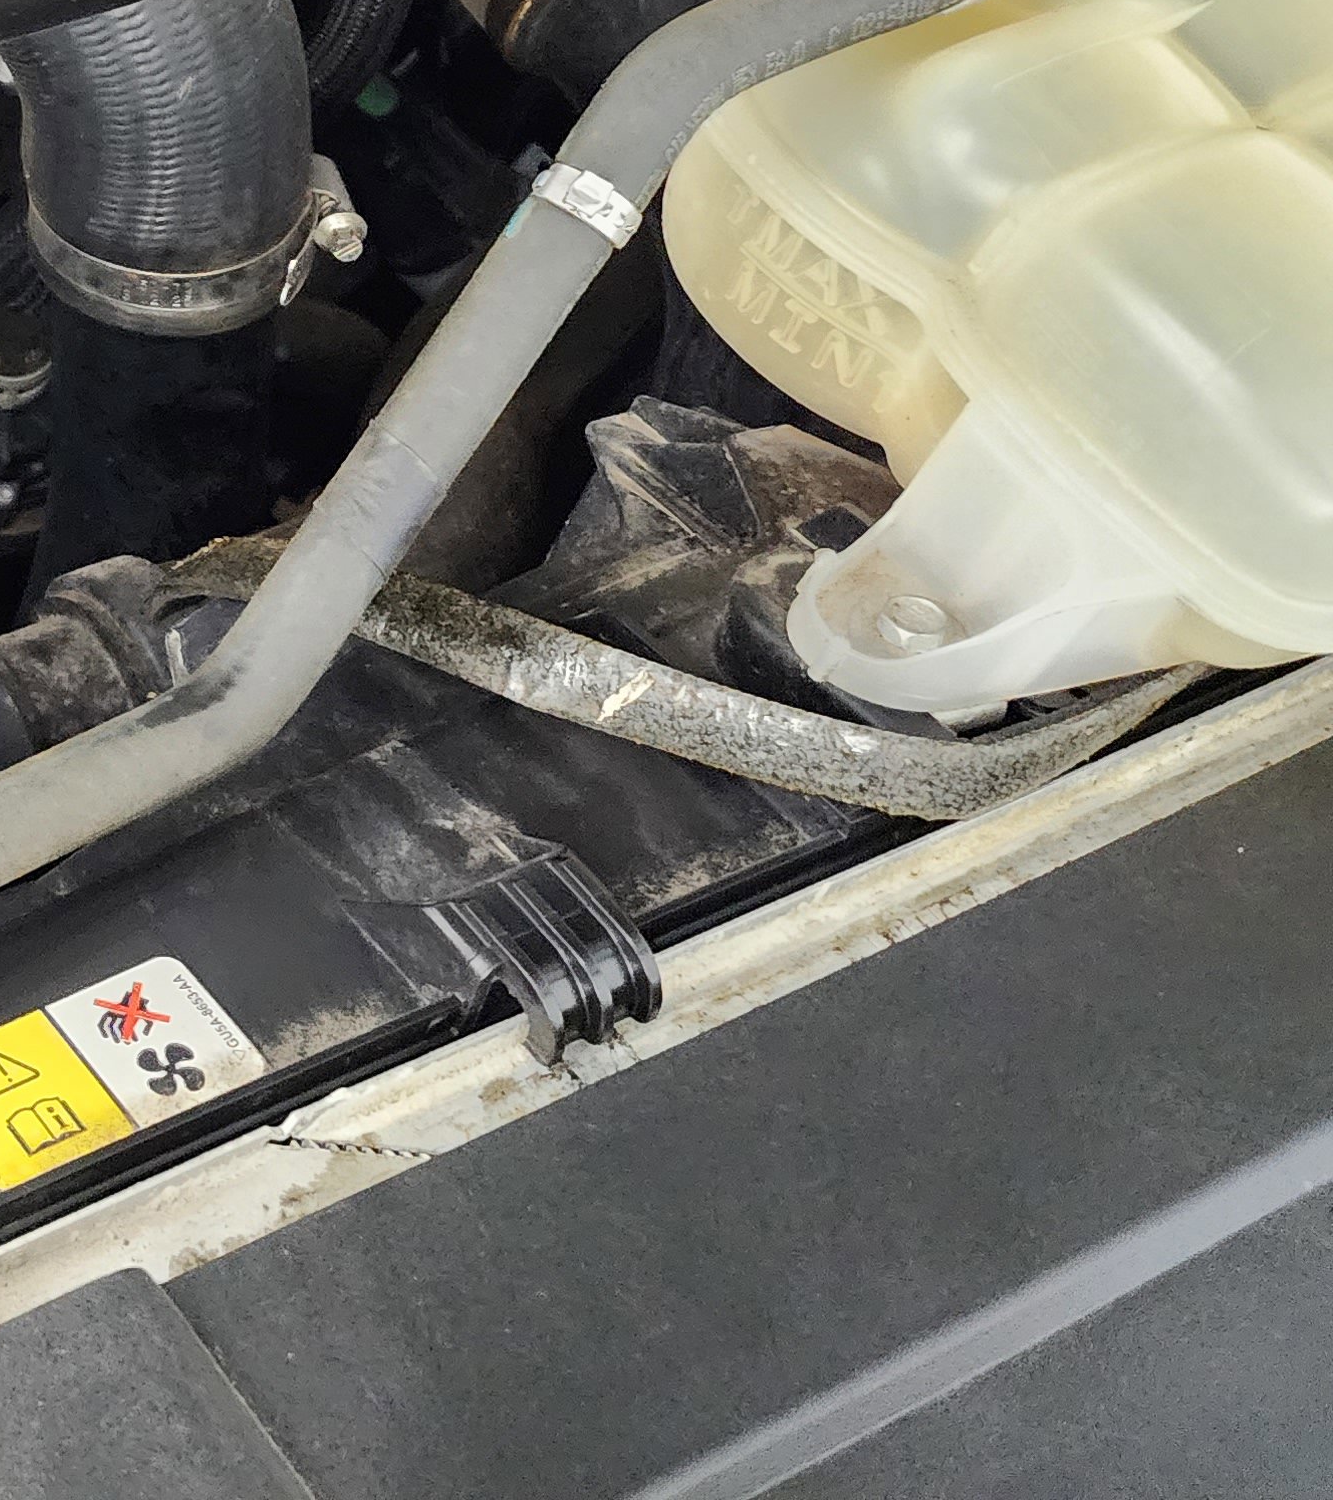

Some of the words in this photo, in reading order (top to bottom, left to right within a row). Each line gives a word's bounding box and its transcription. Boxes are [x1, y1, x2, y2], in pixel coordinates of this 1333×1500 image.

[724, 258, 876, 389] MIN
[736, 212, 888, 338] MAX
[172, 972, 240, 1049] GU5A-8653-AA
